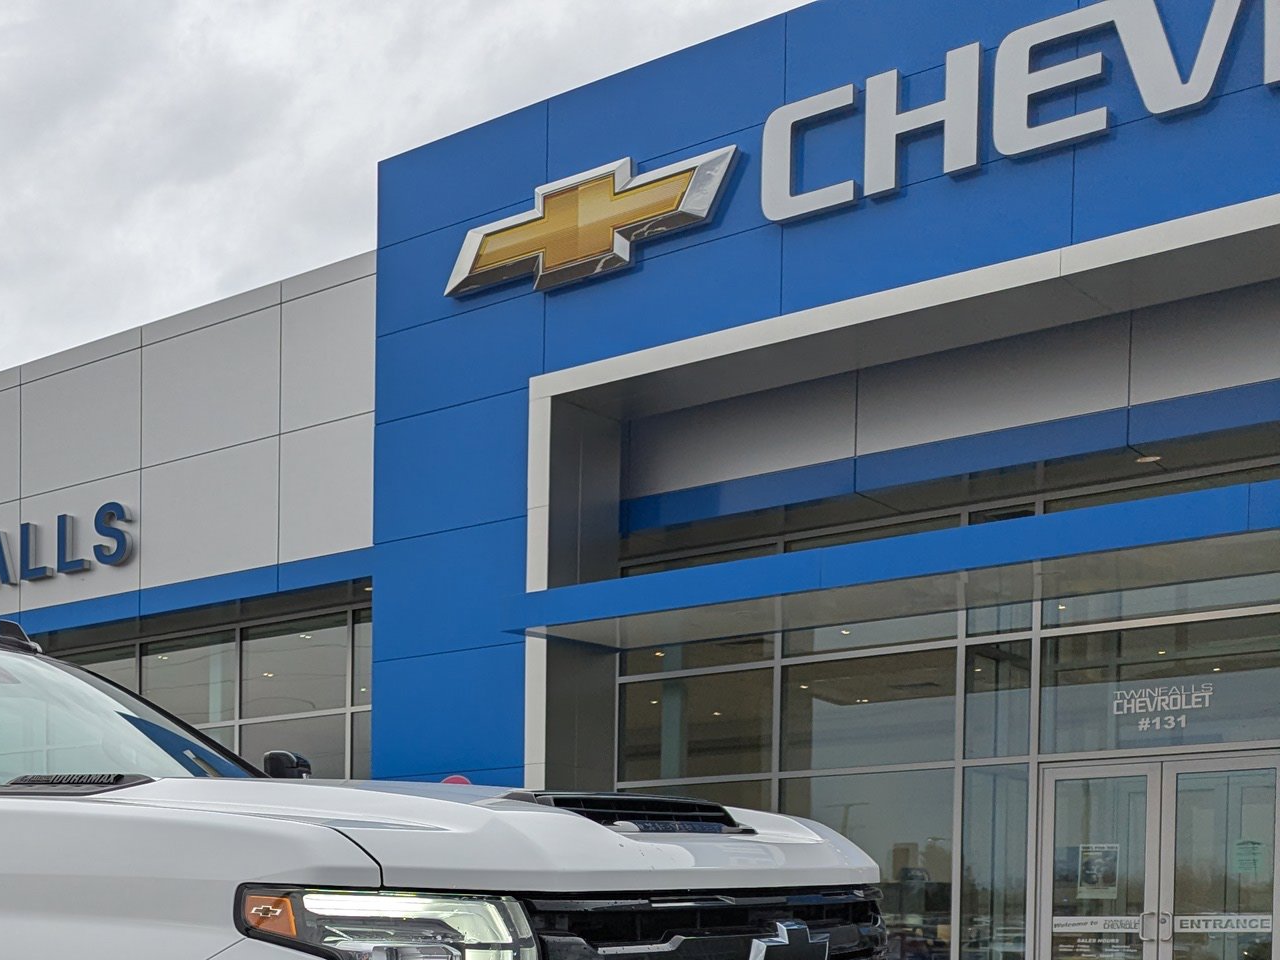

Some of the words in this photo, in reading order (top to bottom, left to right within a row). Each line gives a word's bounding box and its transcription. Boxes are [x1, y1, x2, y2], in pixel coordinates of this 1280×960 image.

[760, 0, 1280, 225] CHEV
[1113, 692, 1213, 715] CHEVROLET
[1138, 714, 1187, 731] #131
[1179, 918, 1271, 929] ENTRANCE
